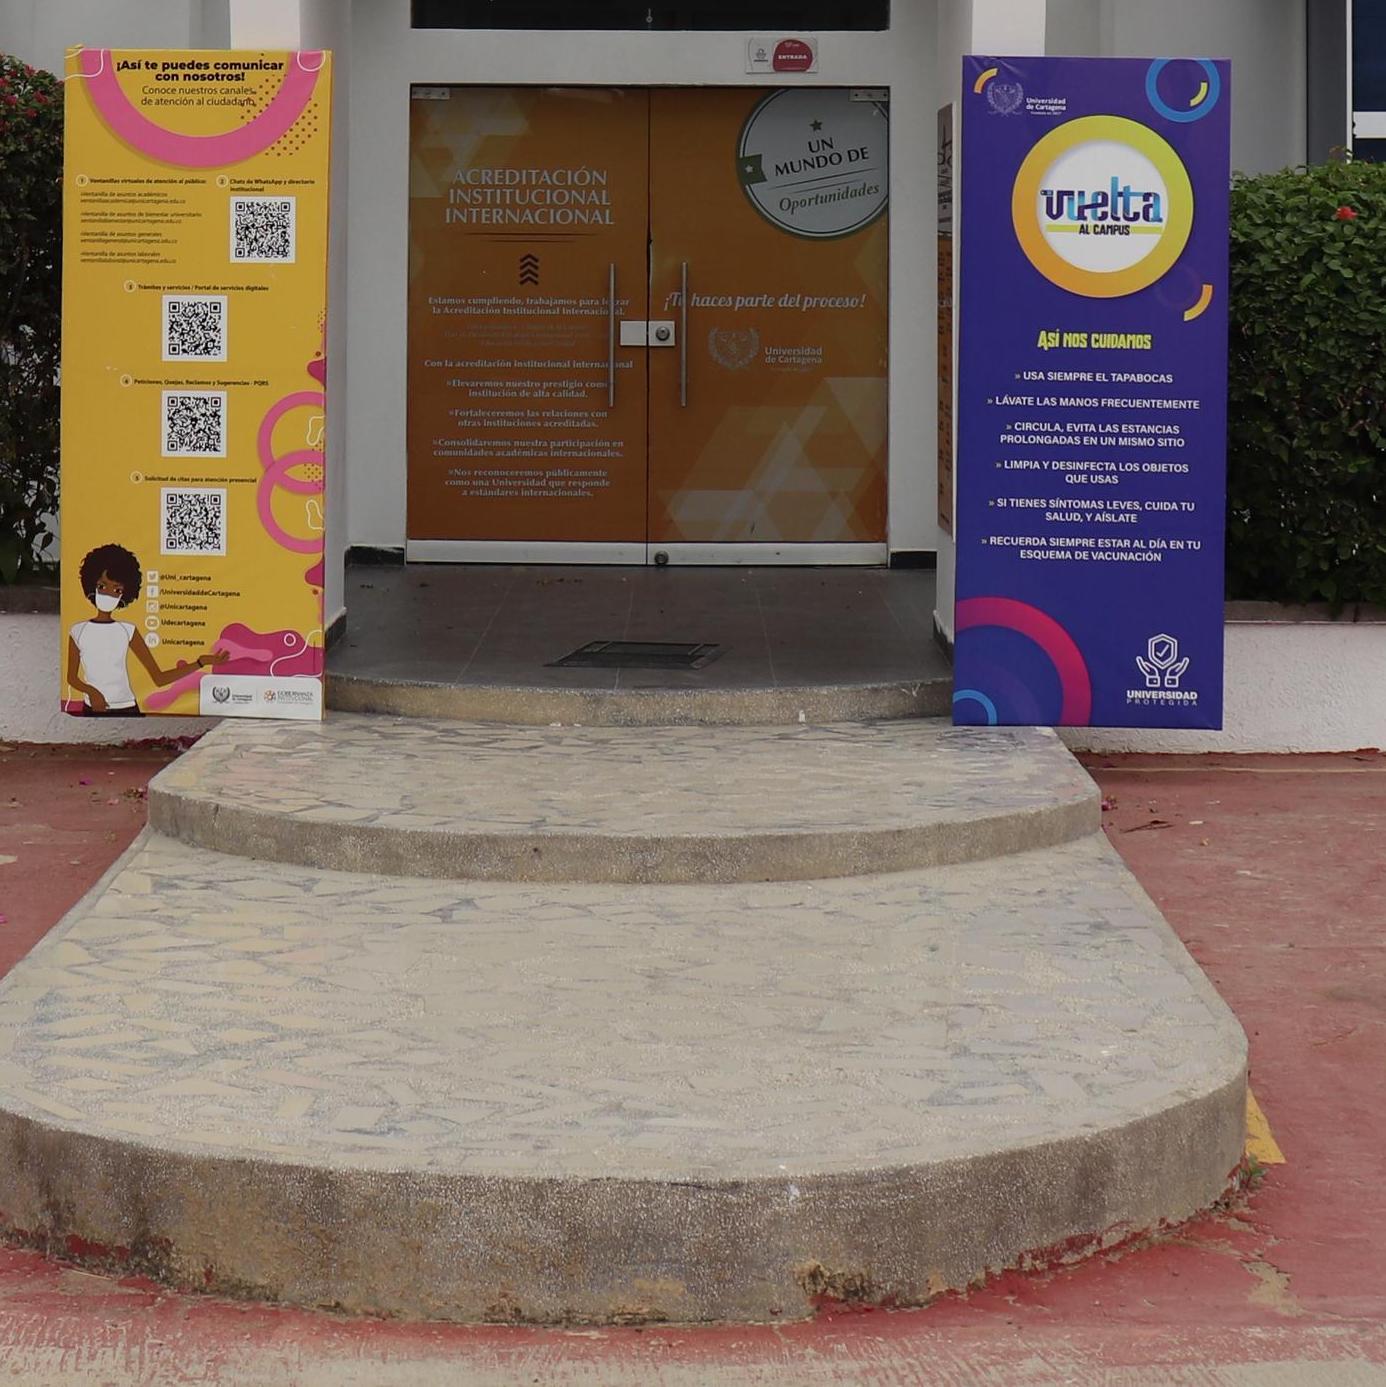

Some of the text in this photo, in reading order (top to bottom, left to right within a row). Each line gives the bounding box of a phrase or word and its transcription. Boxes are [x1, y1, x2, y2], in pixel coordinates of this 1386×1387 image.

[116, 59, 283, 73] ¡Así te puedes comunicar
[155, 71, 244, 81] con nosotros!
[142, 86, 176, 94] Conoce
[141, 96, 152, 105] de
[155, 97, 193, 105] atención
[808, 137, 834, 153] UN
[775, 146, 870, 176] MUNDO DE
[452, 166, 606, 185] ACREDITACIÓN
[450, 188, 610, 205] INSTITUCIONAL
[779, 182, 880, 215] Oportunidades
[446, 208, 614, 224] INTERNACIONAL
[1023, 372, 1172, 382] USA SIEMPRE EL TAPABOCAS
[996, 395, 1199, 409] LÁVATE LAS MANOS FRECUENTEMENTE
[1014, 422, 1179, 434] CIRCULA, EVITA LAS ESTANCIAS
[1000, 435, 1184, 446] PROLONGADAS EN UN MISMO SITIO
[1004, 460, 1188, 472] LIMPIA Y DESINFECTA LOS OBJETOS
[1065, 474, 1118, 483] QUE USAS
[997, 498, 1194, 511] SI TIENES SÍNTOMAS LEVES, CUIDA TU
[1045, 511, 1136, 522] SALUD, Y AÍSLATE
[990, 536, 1200, 549] RECUERDA SIEMPRE ESTAR AL DÍA EN TU
[1020, 549, 1161, 561] ESQUEMA DE VACUNACIÓN
[1126, 690, 1198, 700] UNIVERSIDAD
